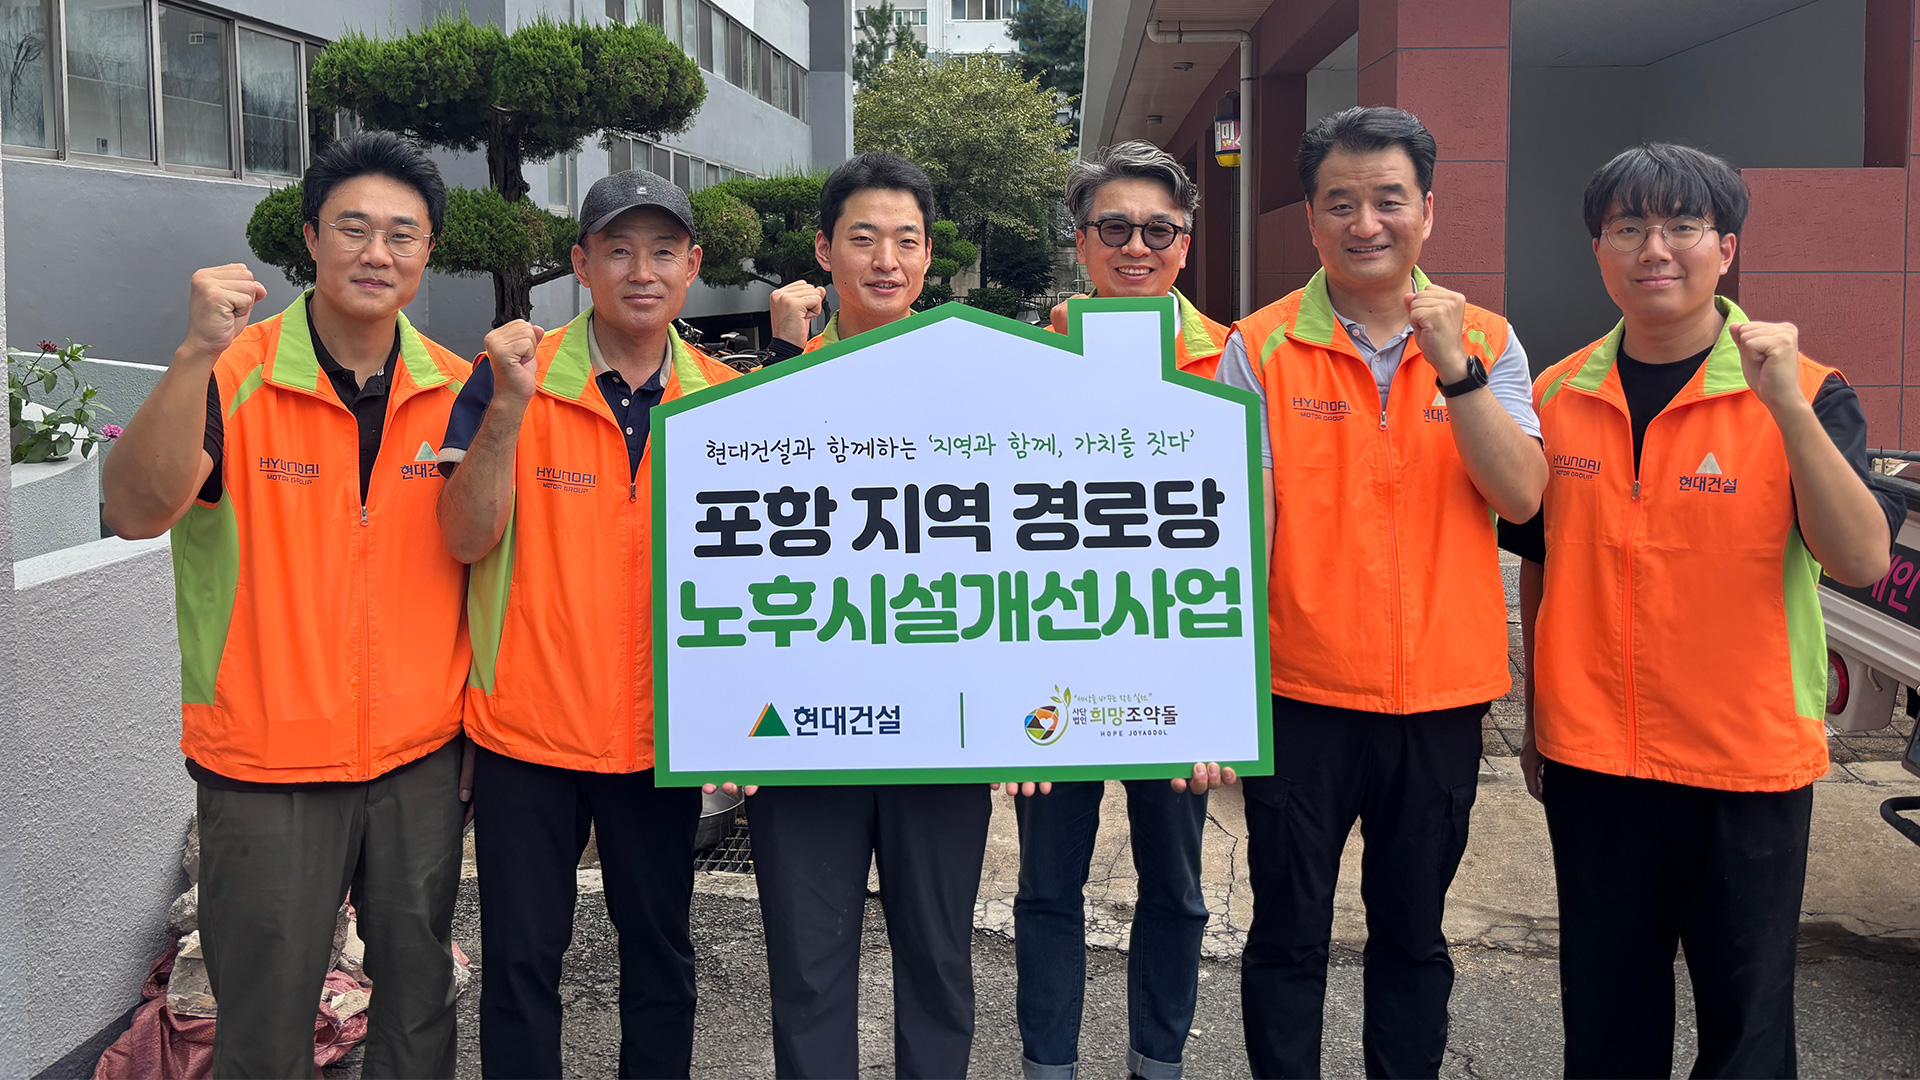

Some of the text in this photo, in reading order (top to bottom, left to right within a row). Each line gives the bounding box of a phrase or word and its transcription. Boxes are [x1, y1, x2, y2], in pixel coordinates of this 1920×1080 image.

[1293, 397, 1351, 411] HYUNDAI
[1301, 412, 1345, 422] MOTOR GROUP
[706, 437, 815, 465] 현대건설과
[827, 435, 917, 463] 함께하는
[928, 433, 997, 459] ‘지역과
[1007, 431, 1063, 458] 함께,
[1074, 428, 1136, 458] 가치를
[260, 457, 319, 474] HYUNDAI
[400, 463, 440, 480] 현대건
[1553, 454, 1601, 472] HYUNDAI
[267, 474, 312, 485] MOTOR GROUP
[537, 466, 596, 485] HYUNDAI
[1571, 472, 1592, 480] GROUP
[1679, 476, 1737, 493] 현대건설
[693, 477, 1226, 558] 포항 지역 경로당
[676, 566, 1243, 648] 노후시설개선사업
[1072, 707, 1087, 716] 사단
[1089, 705, 1178, 726] 희망조약돌
[793, 705, 901, 736] 현대건설
[1072, 716, 1087, 725] 법인
